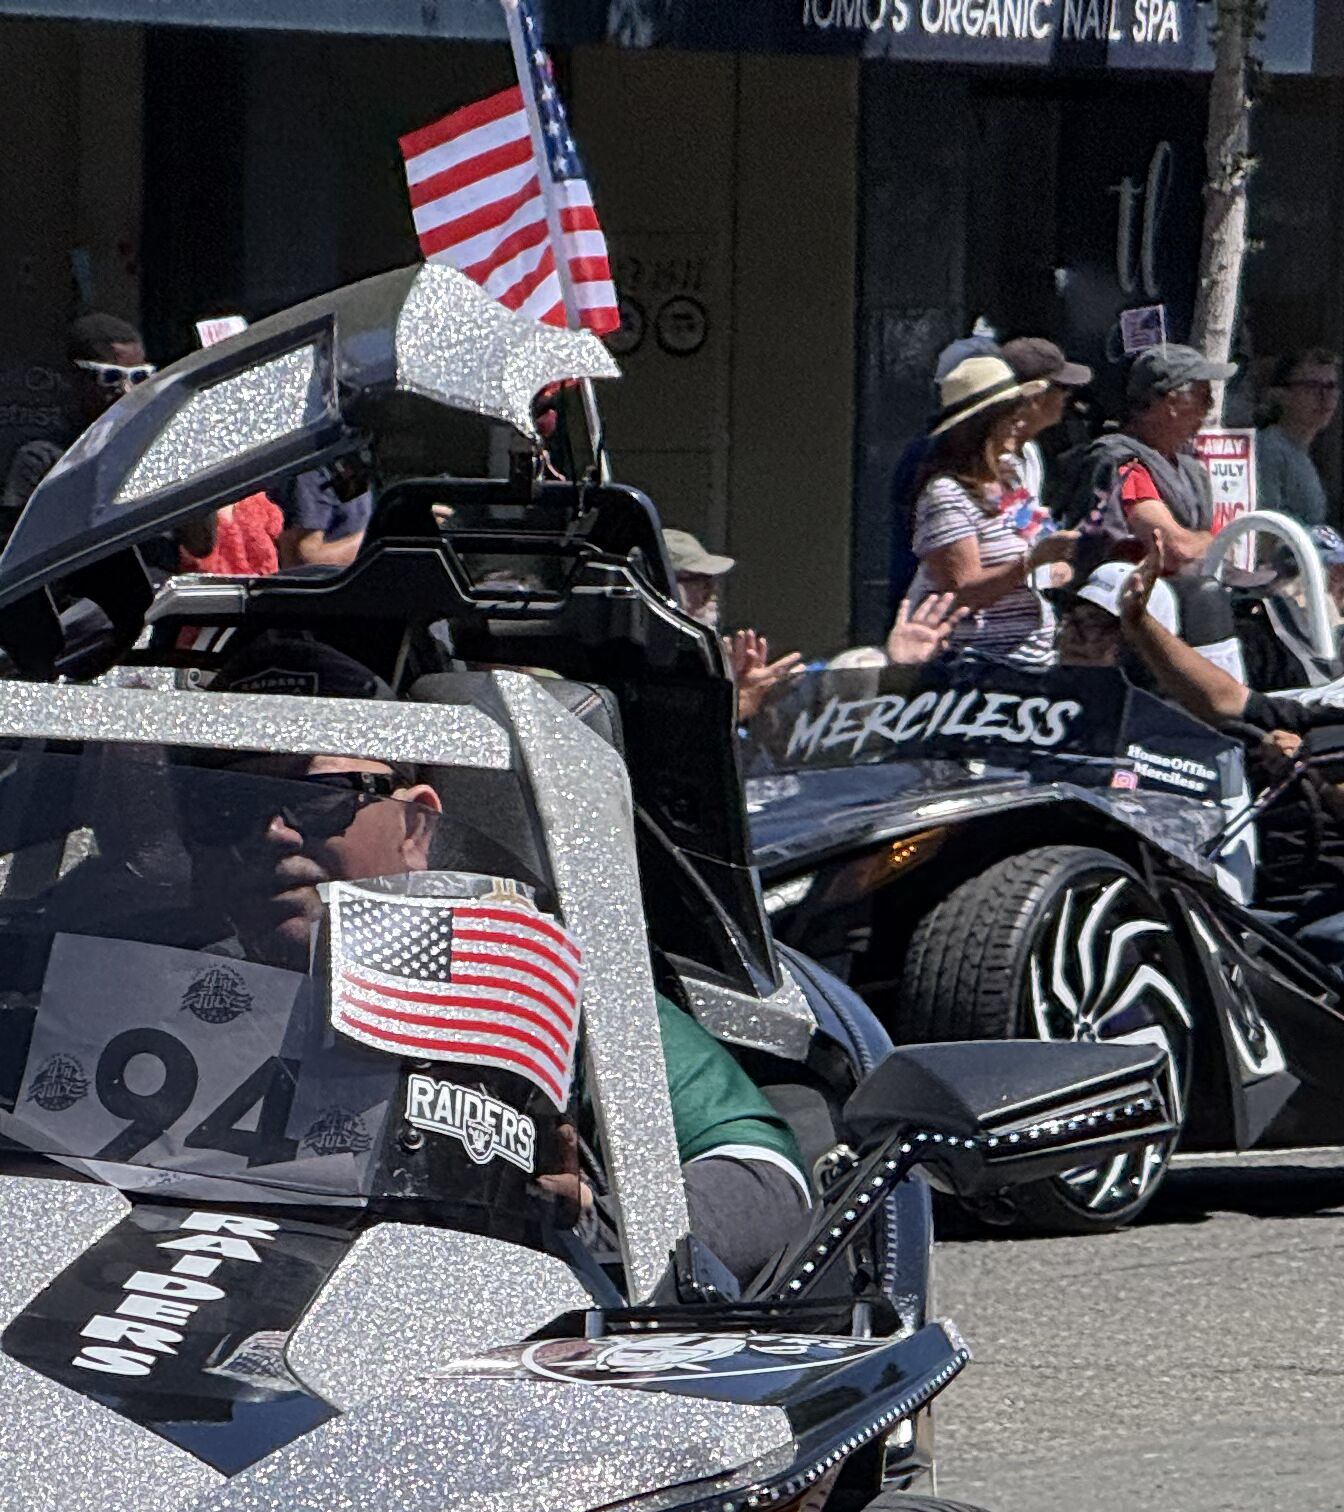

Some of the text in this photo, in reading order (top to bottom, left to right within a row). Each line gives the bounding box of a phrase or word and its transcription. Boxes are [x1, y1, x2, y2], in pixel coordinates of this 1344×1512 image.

[923, 0, 1053, 39] ORGANIC
[1061, 0, 1121, 41] NAIL
[1132, 0, 1181, 44] SPA
[1213, 463, 1245, 477] JULY
[786, 689, 1083, 761] MERCILESS
[193, 991, 234, 1009] JULY
[95, 1027, 301, 1169] 94
[409, 1077, 533, 1161] RAIDERS
[71, 1211, 286, 1377] RAIDERS
